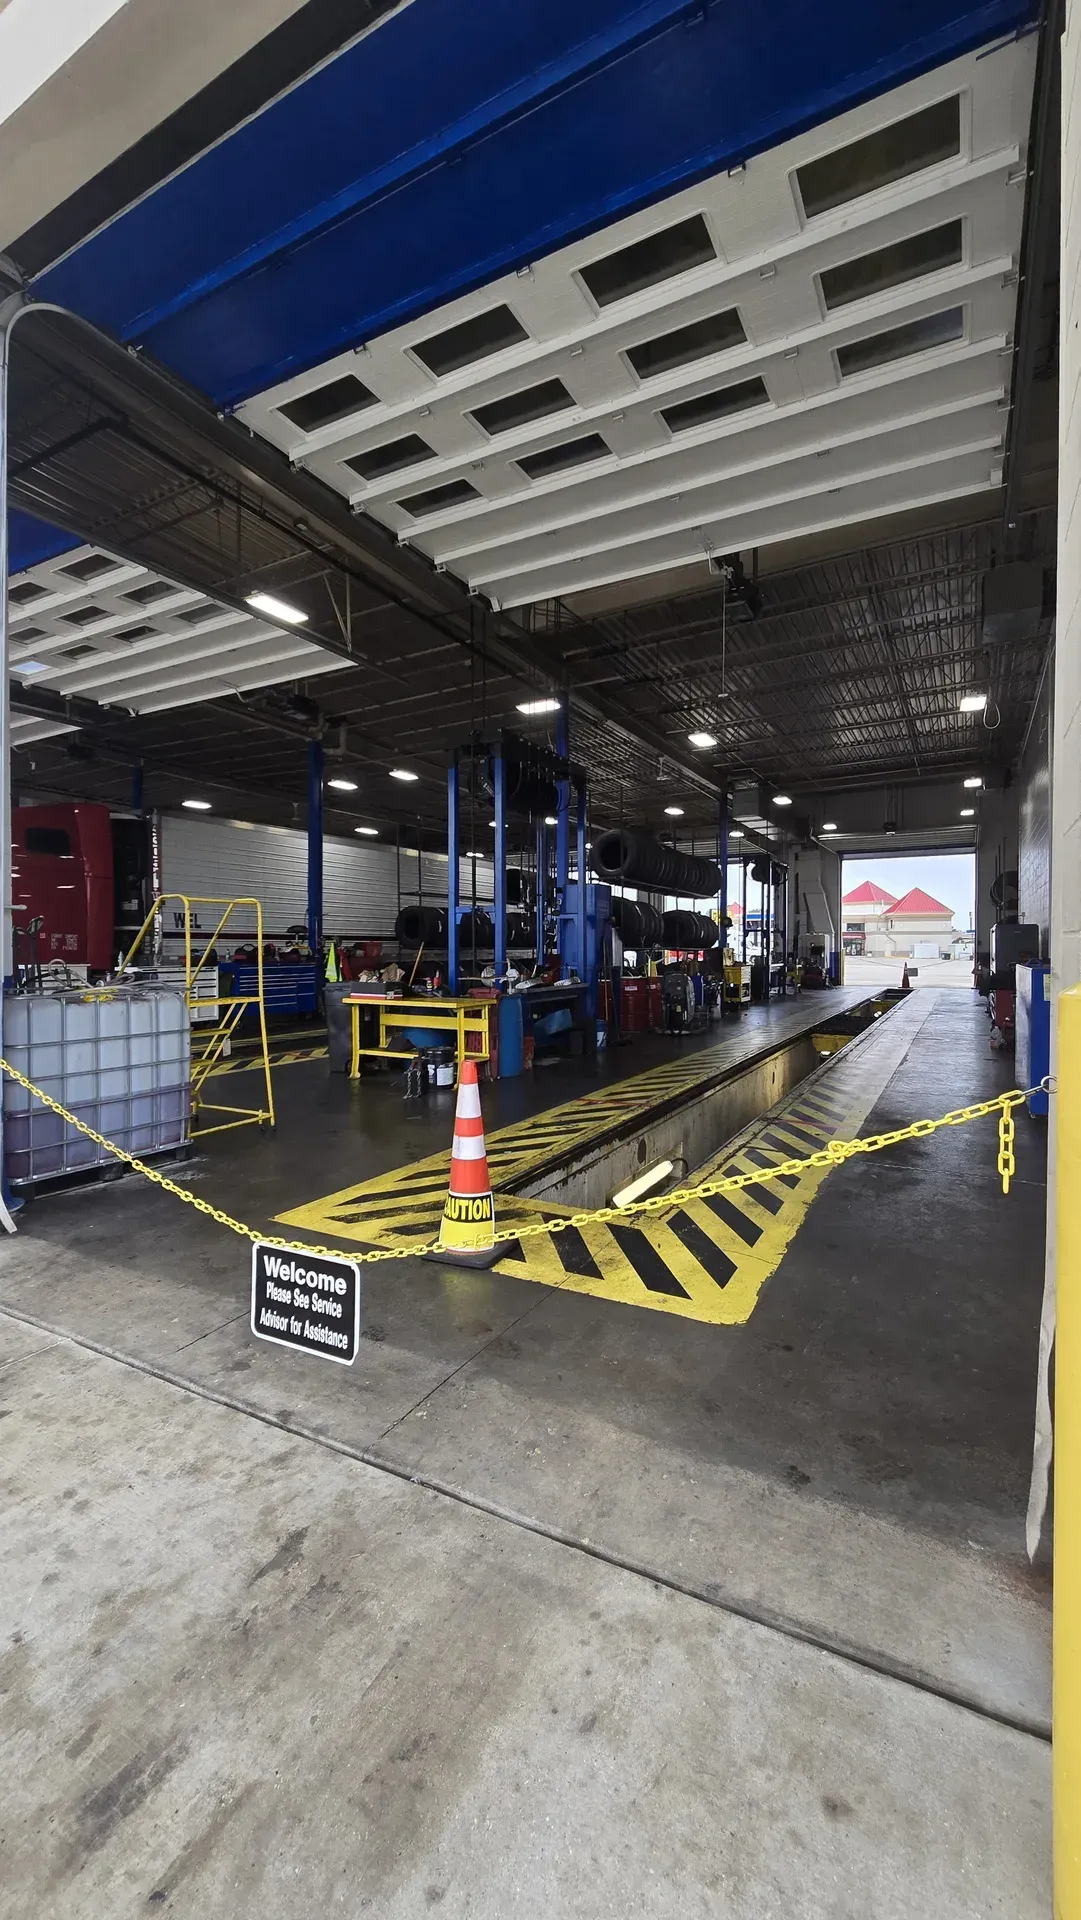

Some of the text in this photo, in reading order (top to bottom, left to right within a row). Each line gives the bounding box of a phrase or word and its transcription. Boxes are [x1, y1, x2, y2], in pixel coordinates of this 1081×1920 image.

[173, 912, 202, 928] WEL
[445, 1196, 491, 1220] AUTION
[263, 1255, 347, 1296] Welcome
[266, 1281, 342, 1319] Please See Service
[259, 1307, 349, 1350] Advisor for Assistance
